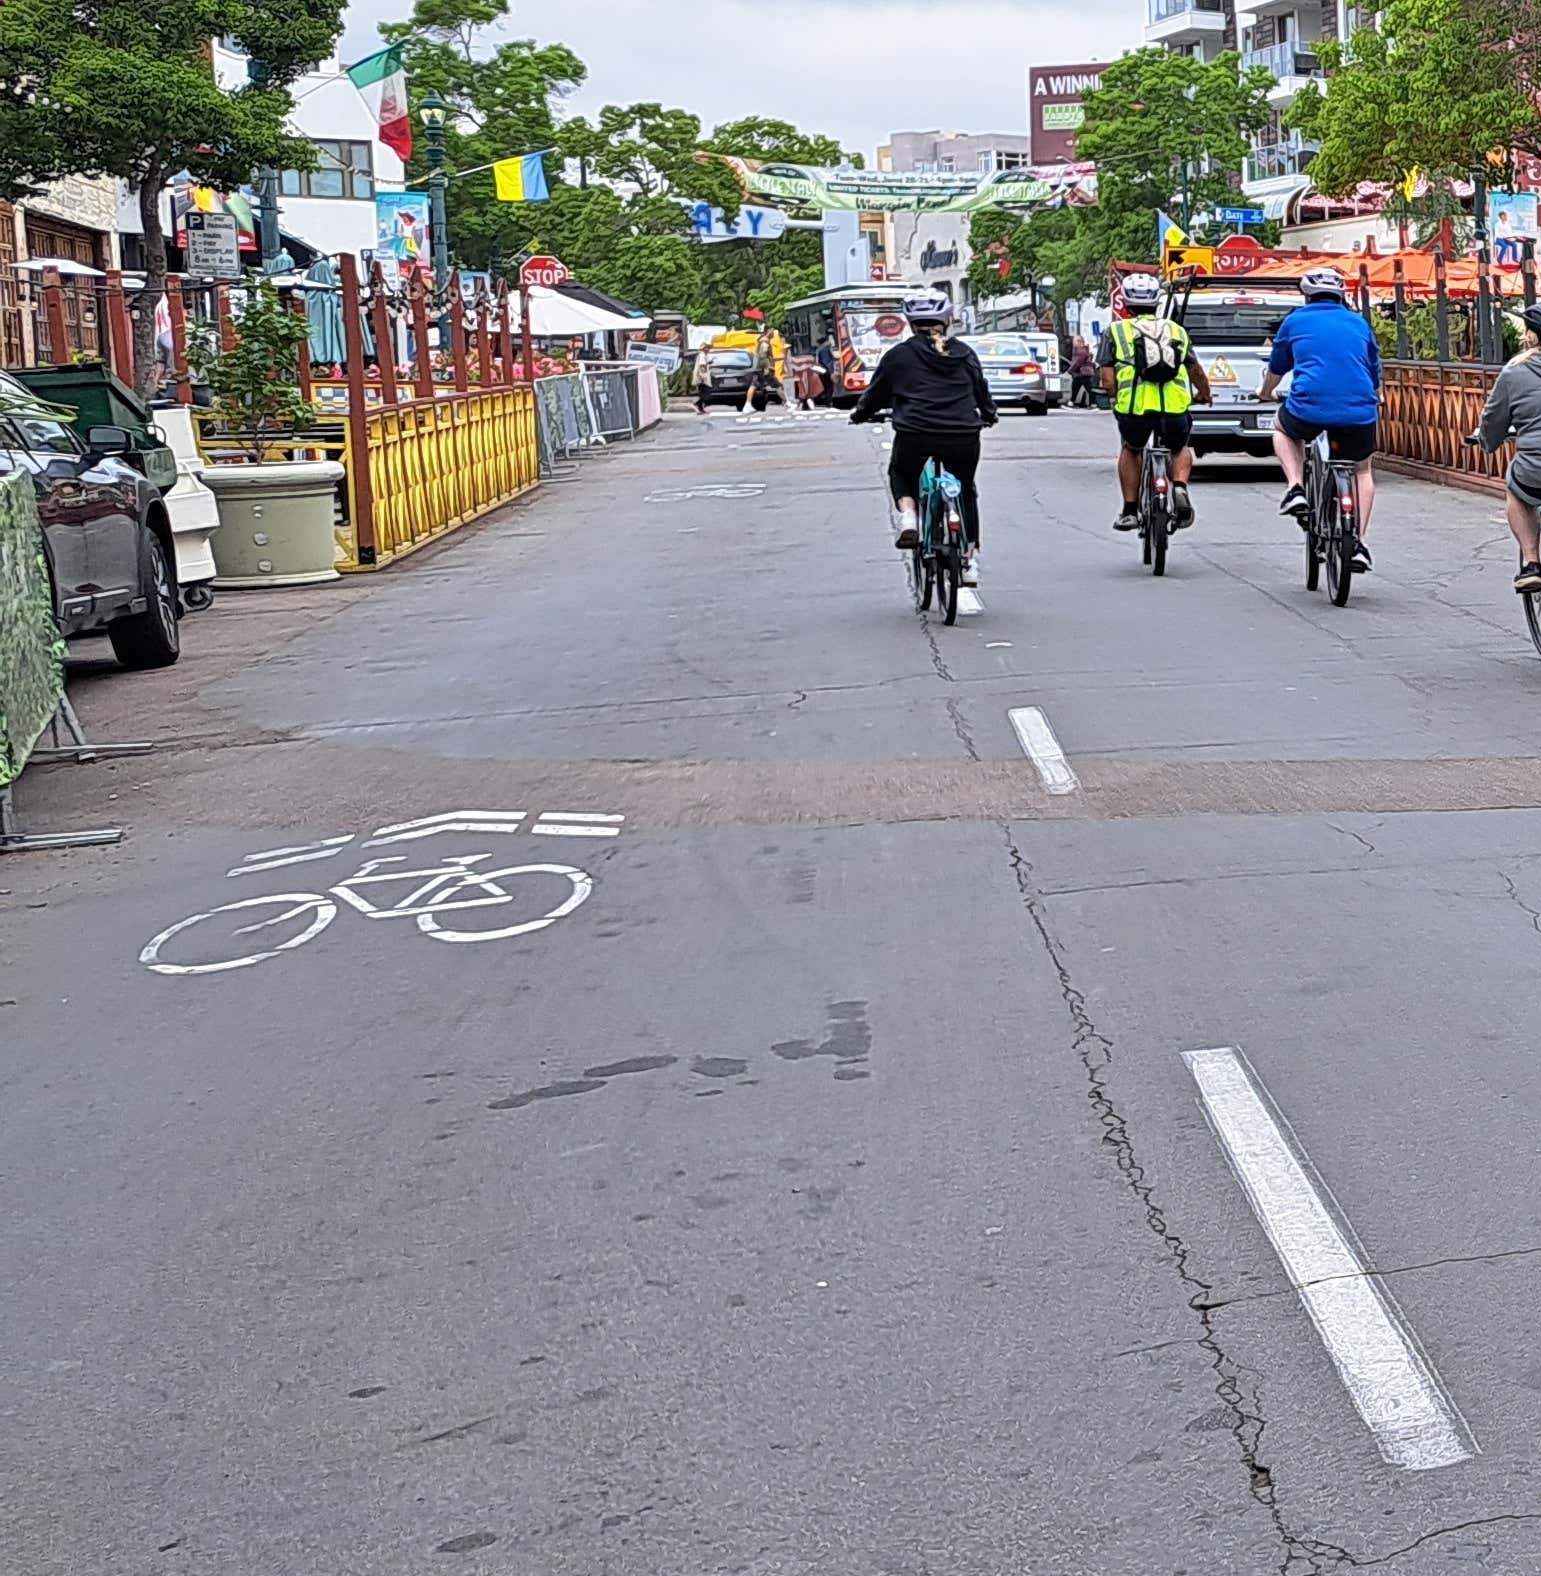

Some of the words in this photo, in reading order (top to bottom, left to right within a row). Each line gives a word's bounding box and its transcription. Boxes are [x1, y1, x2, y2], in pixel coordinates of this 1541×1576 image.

[1034, 77, 1048, 96] A
[1049, 73, 1103, 95] WINNI
[189, 214, 202, 228] P
[524, 269, 564, 285] STOP
